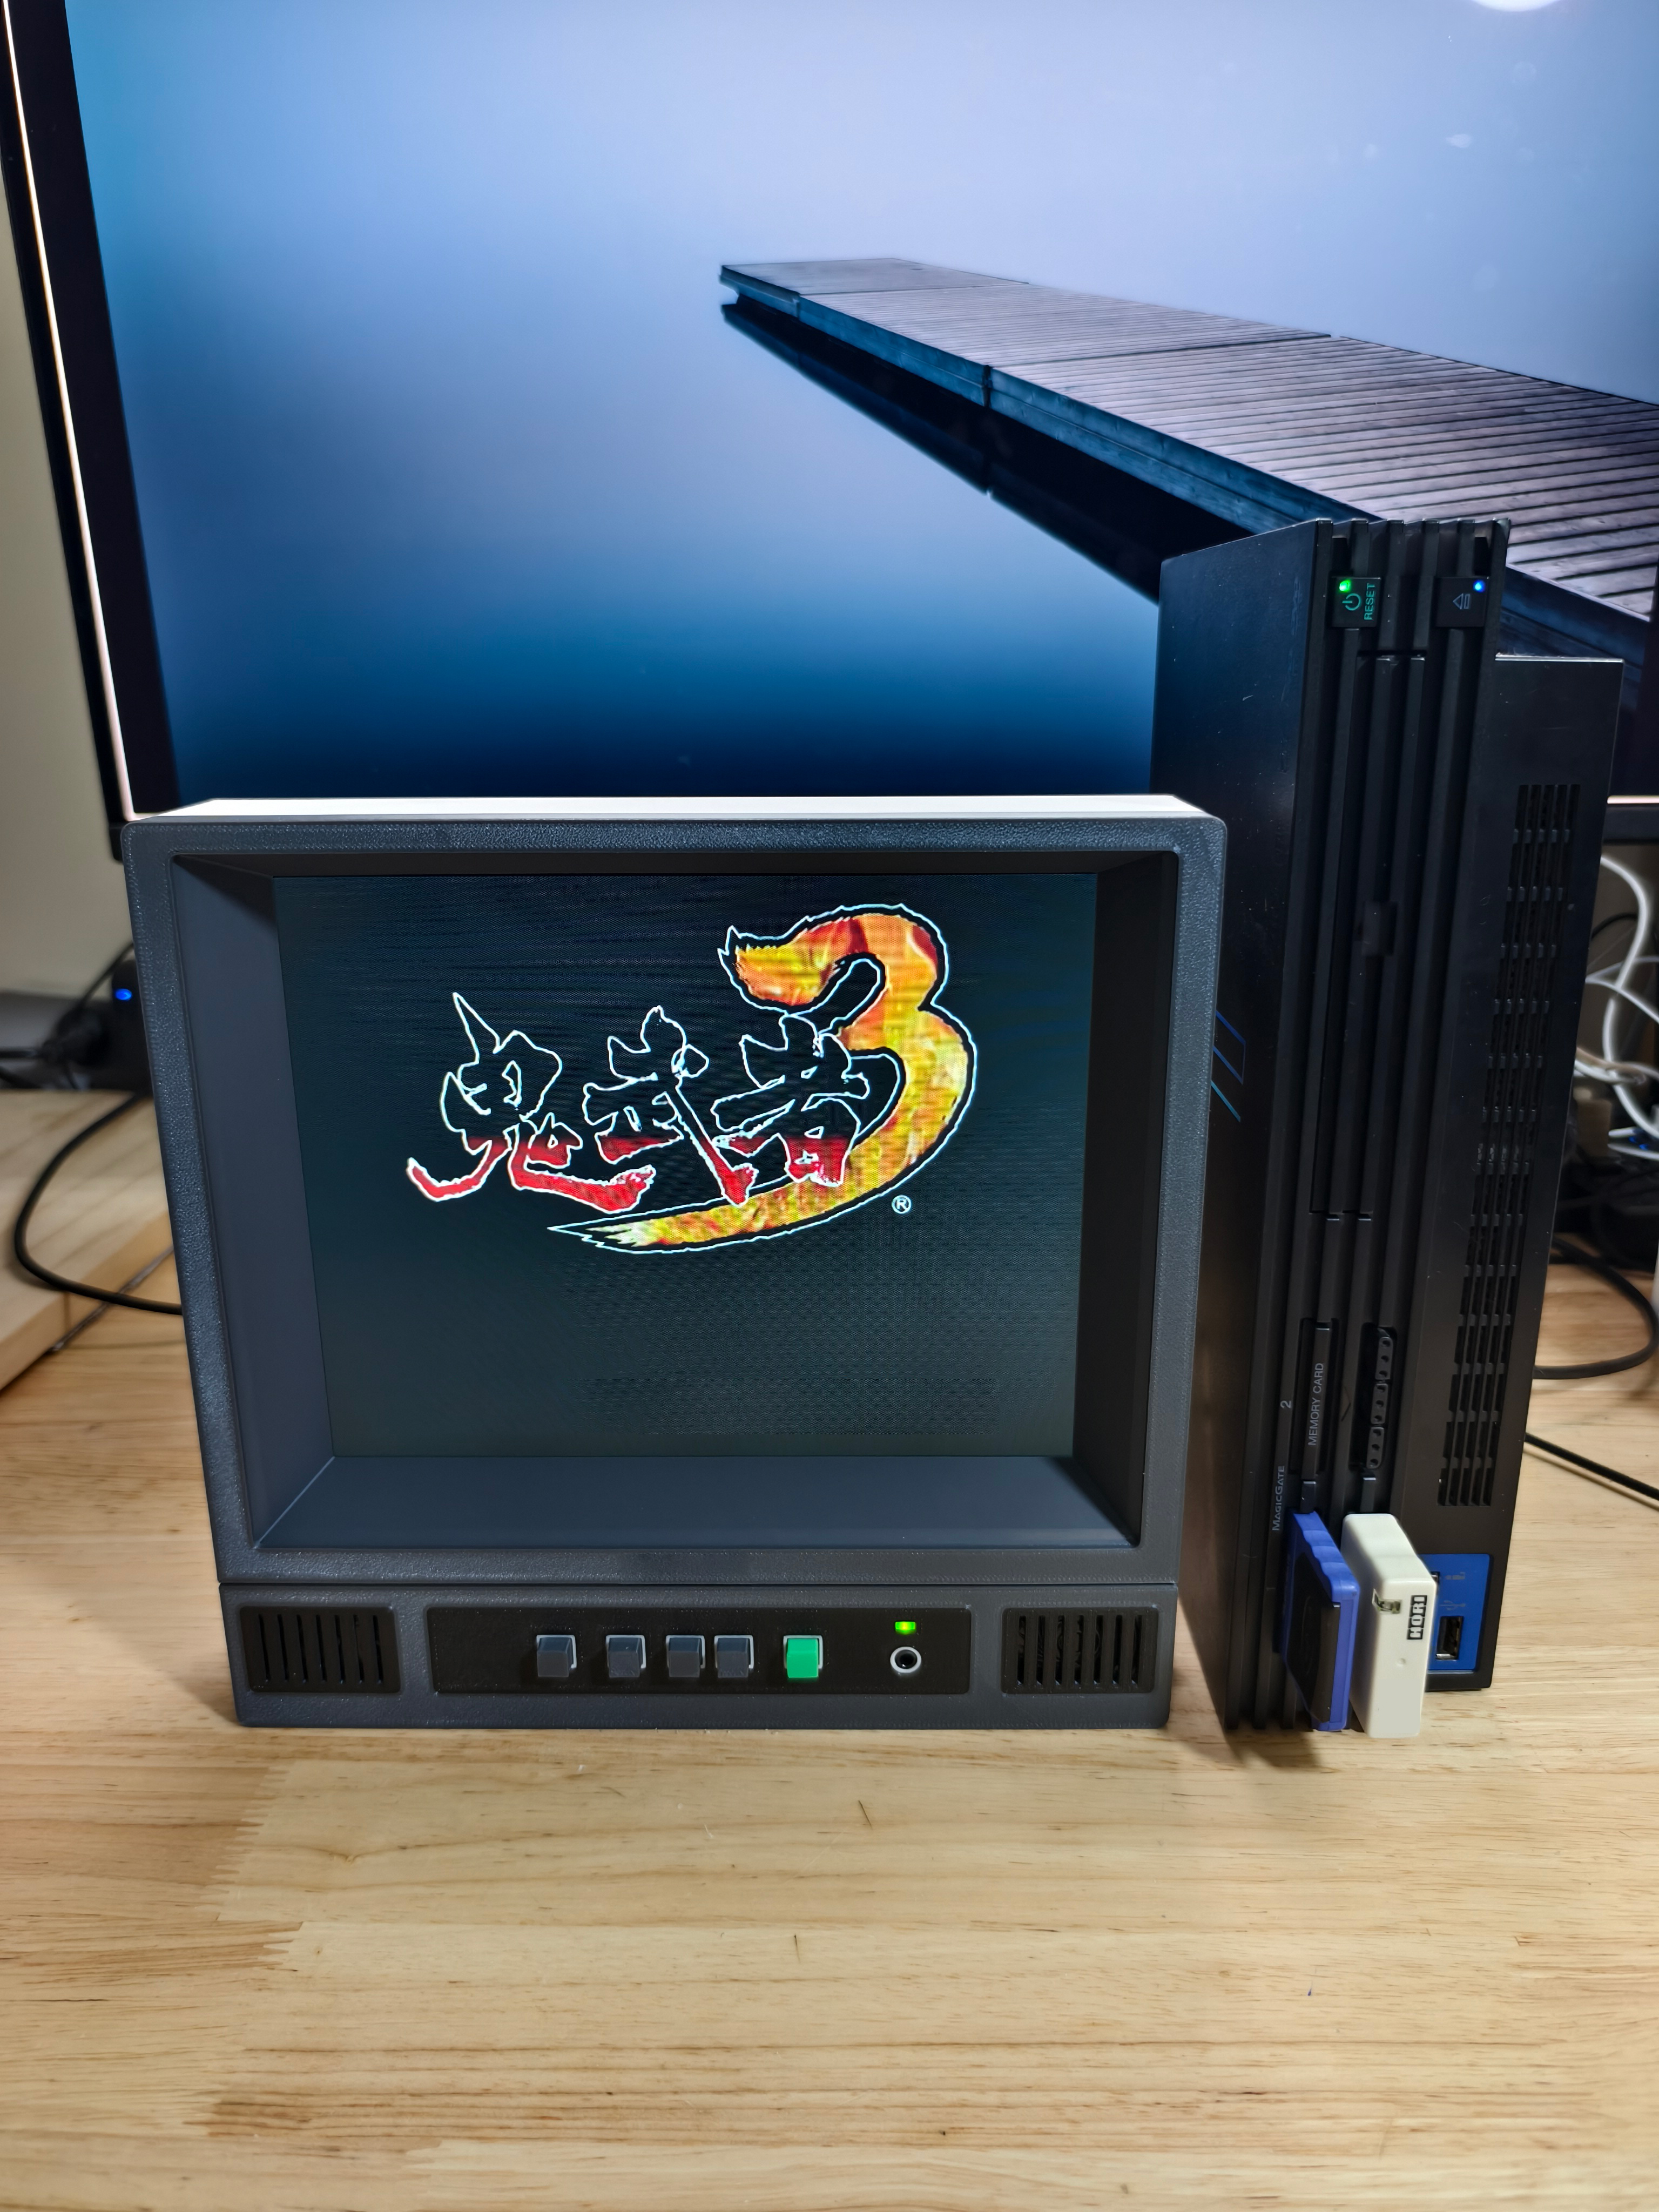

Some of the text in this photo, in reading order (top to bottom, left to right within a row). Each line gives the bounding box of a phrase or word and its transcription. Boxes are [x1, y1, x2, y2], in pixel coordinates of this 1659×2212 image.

[1364, 583, 1375, 620] RESET
[1280, 1400, 1292, 1409] 2
[1308, 1363, 1324, 1446] MEMORY CARD
[1408, 1595, 1426, 1639] HORI
